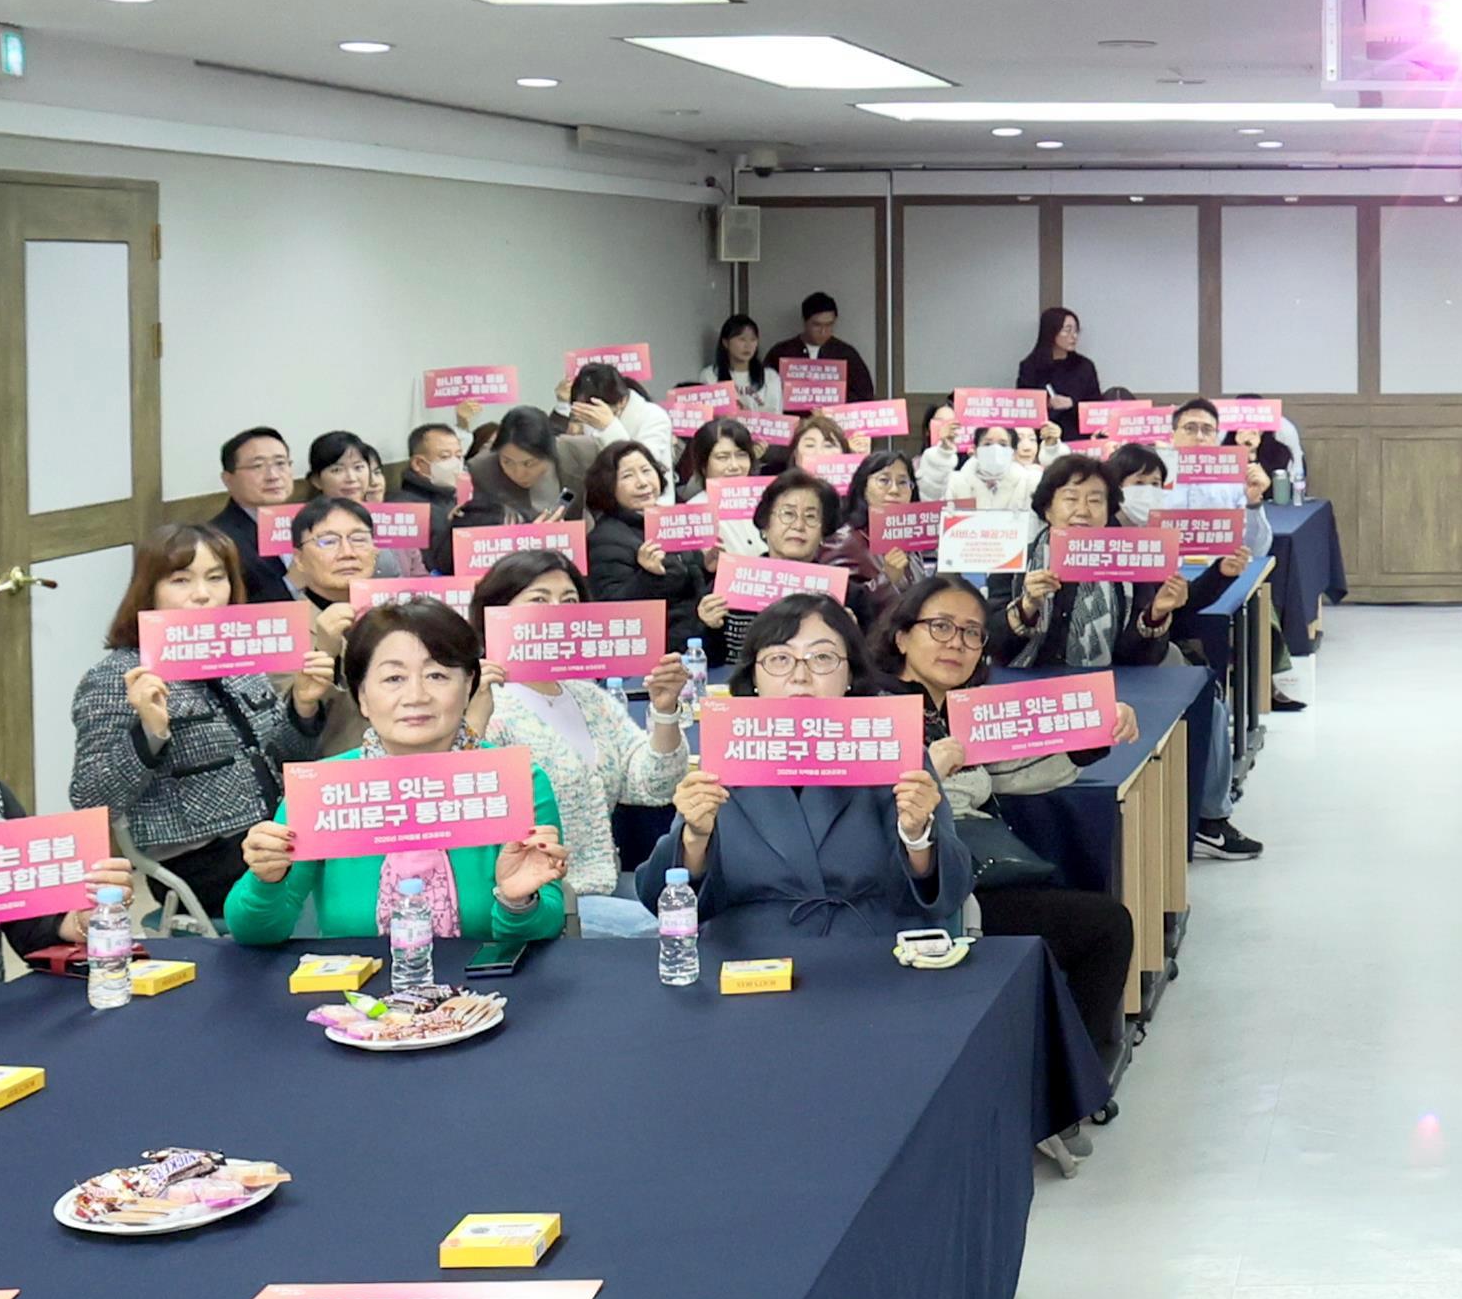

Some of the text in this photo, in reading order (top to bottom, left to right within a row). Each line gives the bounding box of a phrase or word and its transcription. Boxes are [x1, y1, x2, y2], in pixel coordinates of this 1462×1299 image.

[1068, 539, 1105, 552] 하나로
[1108, 539, 1133, 552] 잇는
[1063, 553, 1113, 566] 서대문구
[167, 623, 216, 643] 하나로
[219, 620, 251, 639] 잇는
[515, 621, 565, 641] 하나로
[569, 619, 603, 639] 잇는
[162, 640, 226, 662] 서대문구
[509, 640, 576, 661] 서대문구
[972, 690, 1093, 723] 하나로 잇는 돌봄
[733, 717, 891, 738] 하나로 잇는 돌봄
[969, 708, 1100, 743] 서대문구 통합돌봄
[725, 740, 899, 761] 서대문구 통합돌봄
[321, 771, 498, 806] 하나로 잇는 돌봄
[313, 794, 507, 832] 서대문구 통합돌봄
[25, 834, 75, 864] 돌봄
